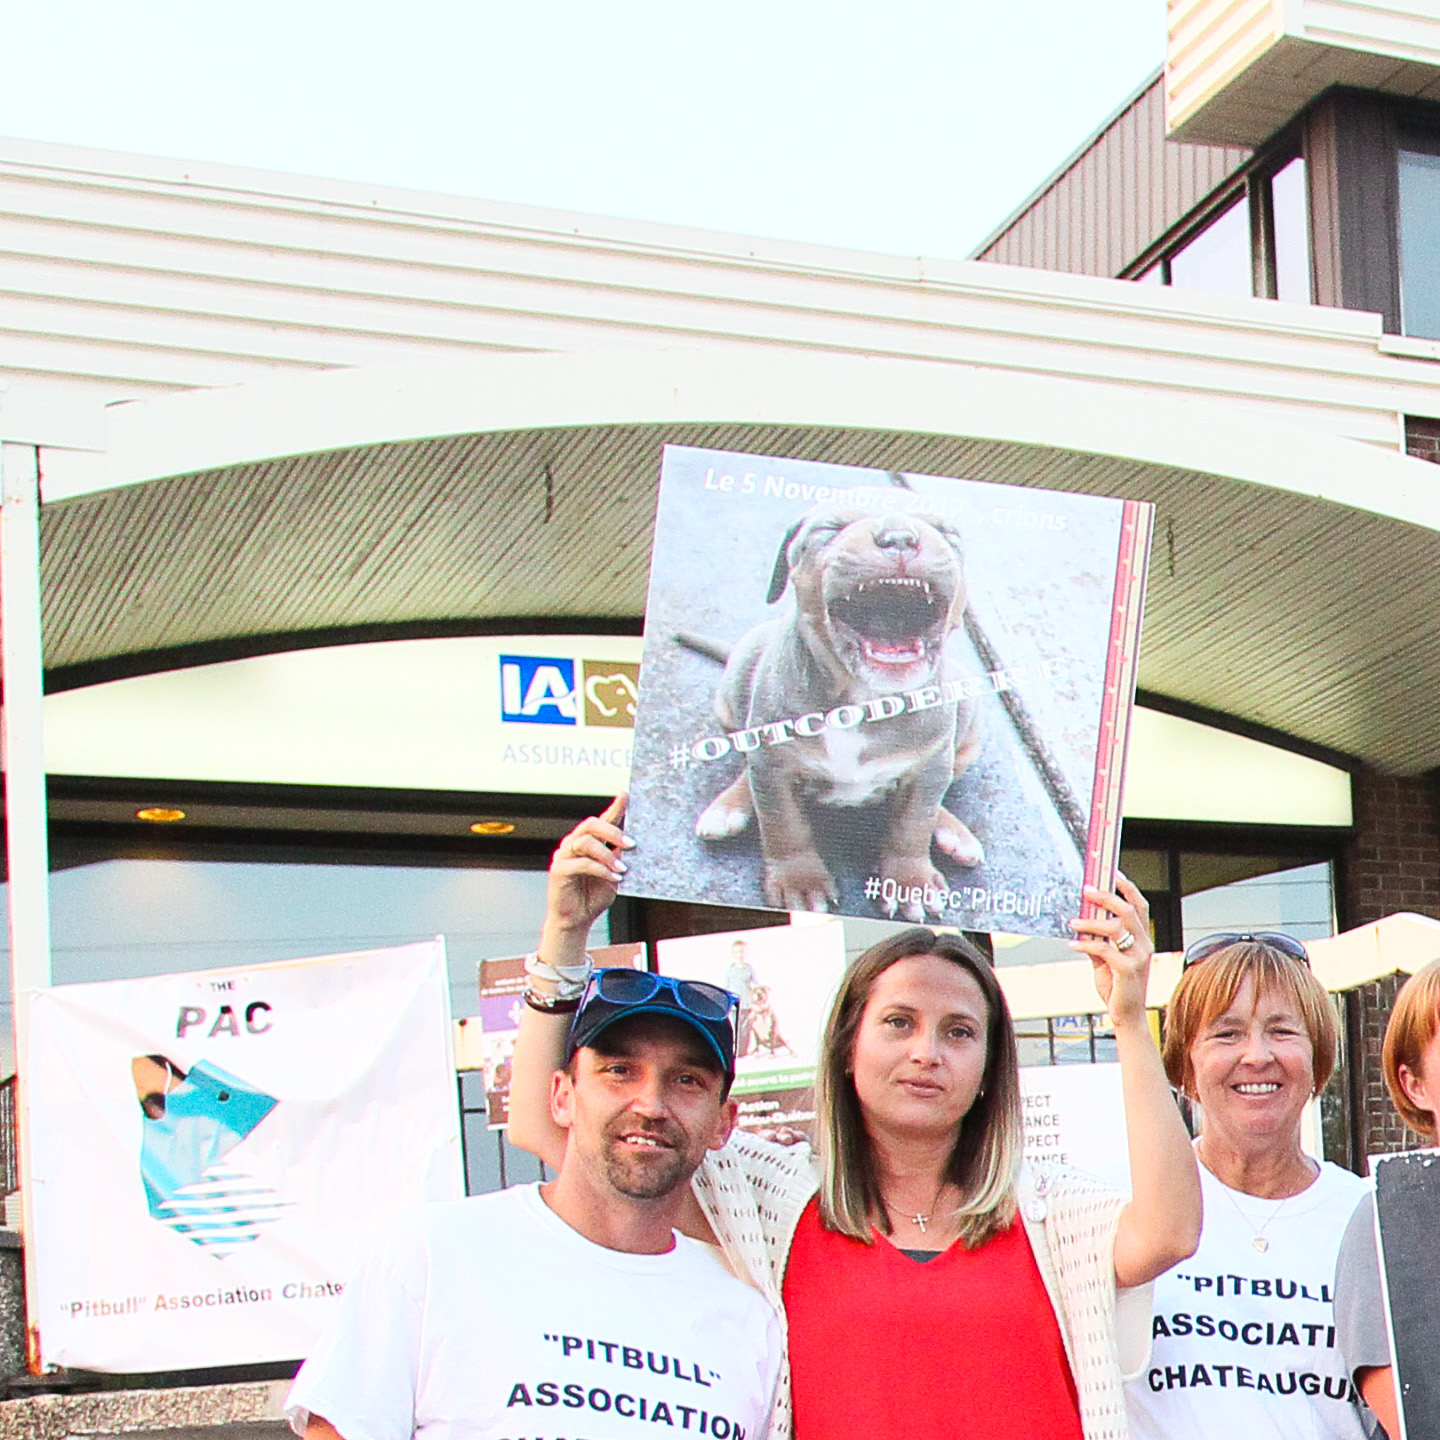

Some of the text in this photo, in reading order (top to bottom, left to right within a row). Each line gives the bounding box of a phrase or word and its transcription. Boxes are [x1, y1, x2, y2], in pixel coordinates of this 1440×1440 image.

[704, 468, 734, 492] Le
[741, 473, 757, 494] 5
[763, 476, 897, 513] Novembre
[991, 503, 1068, 533] crions
[210, 980, 236, 993] THE
[176, 1000, 274, 1039] PAC
[60, 1278, 347, 1319] "Pitbull" Association Chate
[1152, 1313, 1336, 1349] ASSOCIATI
[543, 1333, 722, 1387] "PITBULL"
